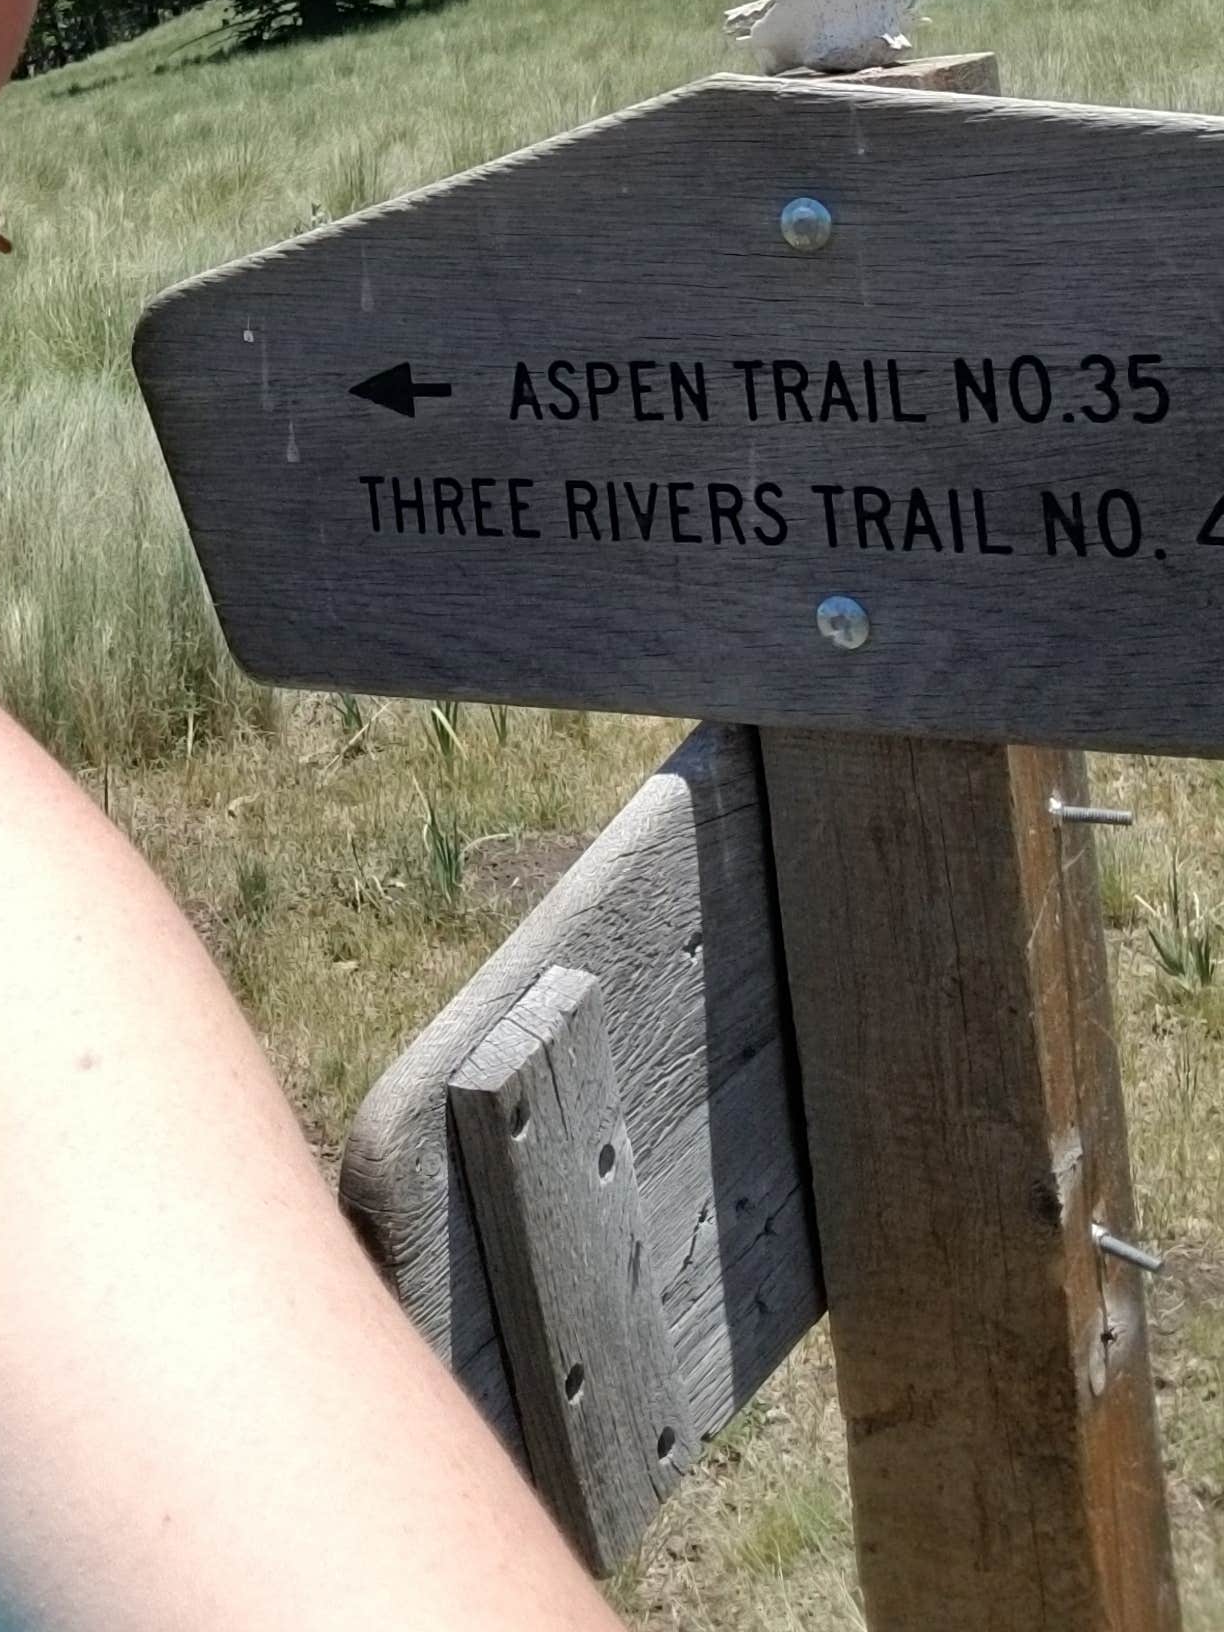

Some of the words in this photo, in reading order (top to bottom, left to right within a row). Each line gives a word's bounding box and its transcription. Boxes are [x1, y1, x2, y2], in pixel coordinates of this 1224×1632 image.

[509, 360, 708, 421] ASPEN
[733, 359, 926, 423] TRAIL
[359, 475, 541, 538] THREE
[565, 479, 788, 546] RIVERS
[812, 485, 1013, 555] TRAIL
[1041, 488, 1166, 560] NO.
